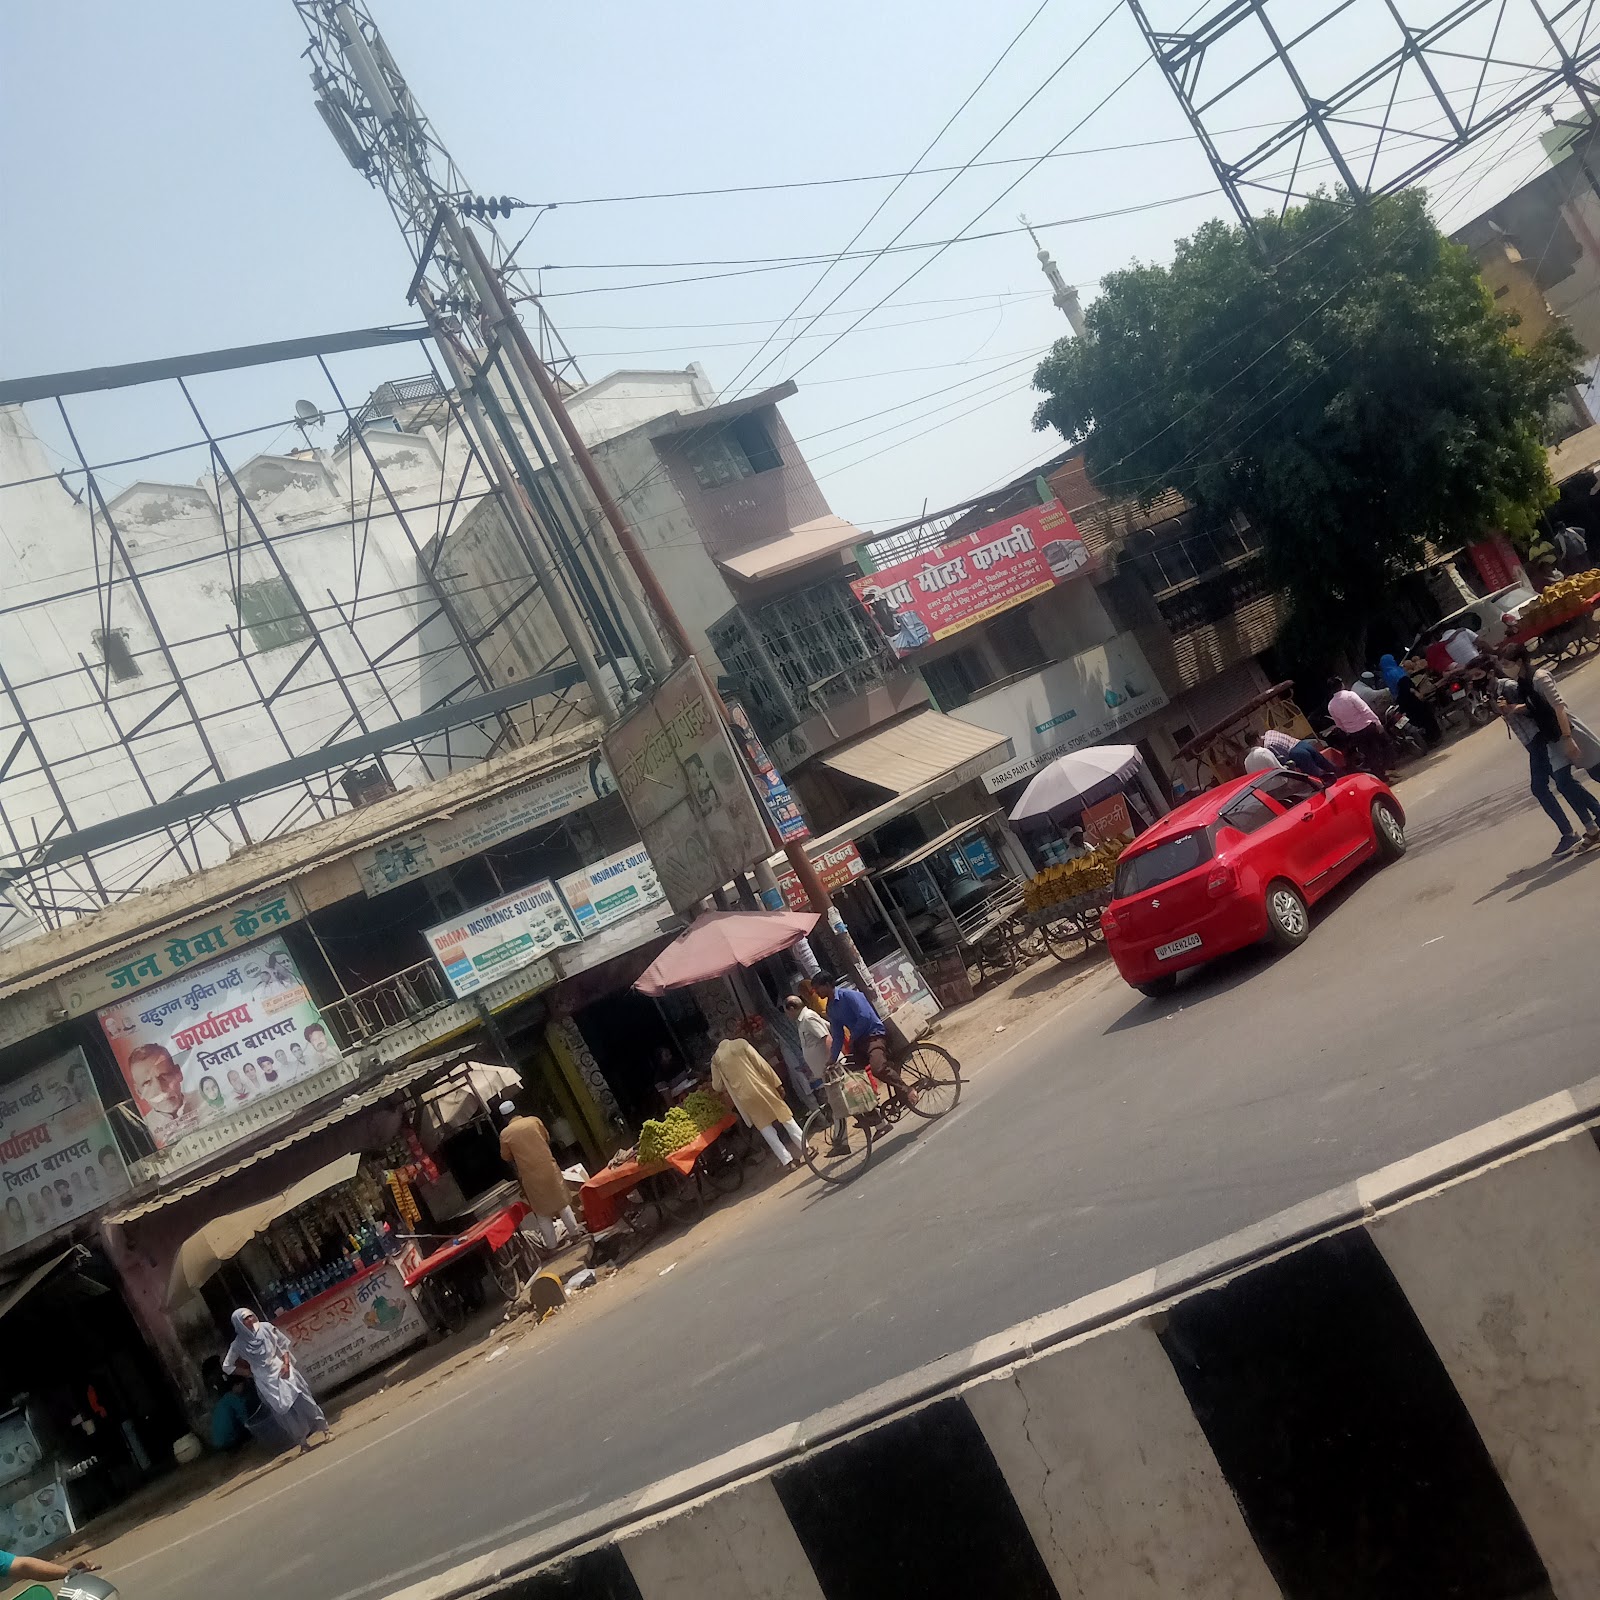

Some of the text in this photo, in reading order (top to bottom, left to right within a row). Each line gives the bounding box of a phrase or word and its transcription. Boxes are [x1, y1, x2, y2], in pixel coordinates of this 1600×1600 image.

[912, 552, 967, 595] मोटर
[967, 523, 1034, 571] कम्पनी
[1039, 719, 1055, 731] WALL
[991, 770, 1013, 786] PARAS
[1011, 762, 1030, 777] PAINT
[1028, 759, 1035, 768] &
[1033, 743, 1068, 765] HARDWARE
[1067, 733, 1087, 749] STORE
[774, 792, 792, 805] Pizza
[590, 861, 626, 885] INSURANCE
[624, 850, 650, 868] SOLUTI
[822, 843, 855, 867] चिकन
[434, 926, 468, 950] DHAMA
[468, 906, 513, 935] INSURANCE
[514, 889, 553, 915] SOLUTION
[106, 954, 161, 992] जन
[164, 923, 227, 967] सेवा
[229, 896, 290, 938] केन्द्र
[1158, 935, 1200, 956] UP14EH2409
[61, 976, 77, 986] CSC
[78, 972, 86, 980] ID
[139, 997, 184, 1030] बहुजन
[182, 979, 218, 1011] मुक्ति
[216, 968, 243, 991] पार्टी
[170, 1001, 252, 1052] कार्यालय
[196, 1017, 296, 1071] जिला बागपत
[17, 1083, 44, 1107] पार्टी
[2, 1138, 92, 1191] जिला बागपत
[354, 1272, 392, 1302] कॉर्नर
